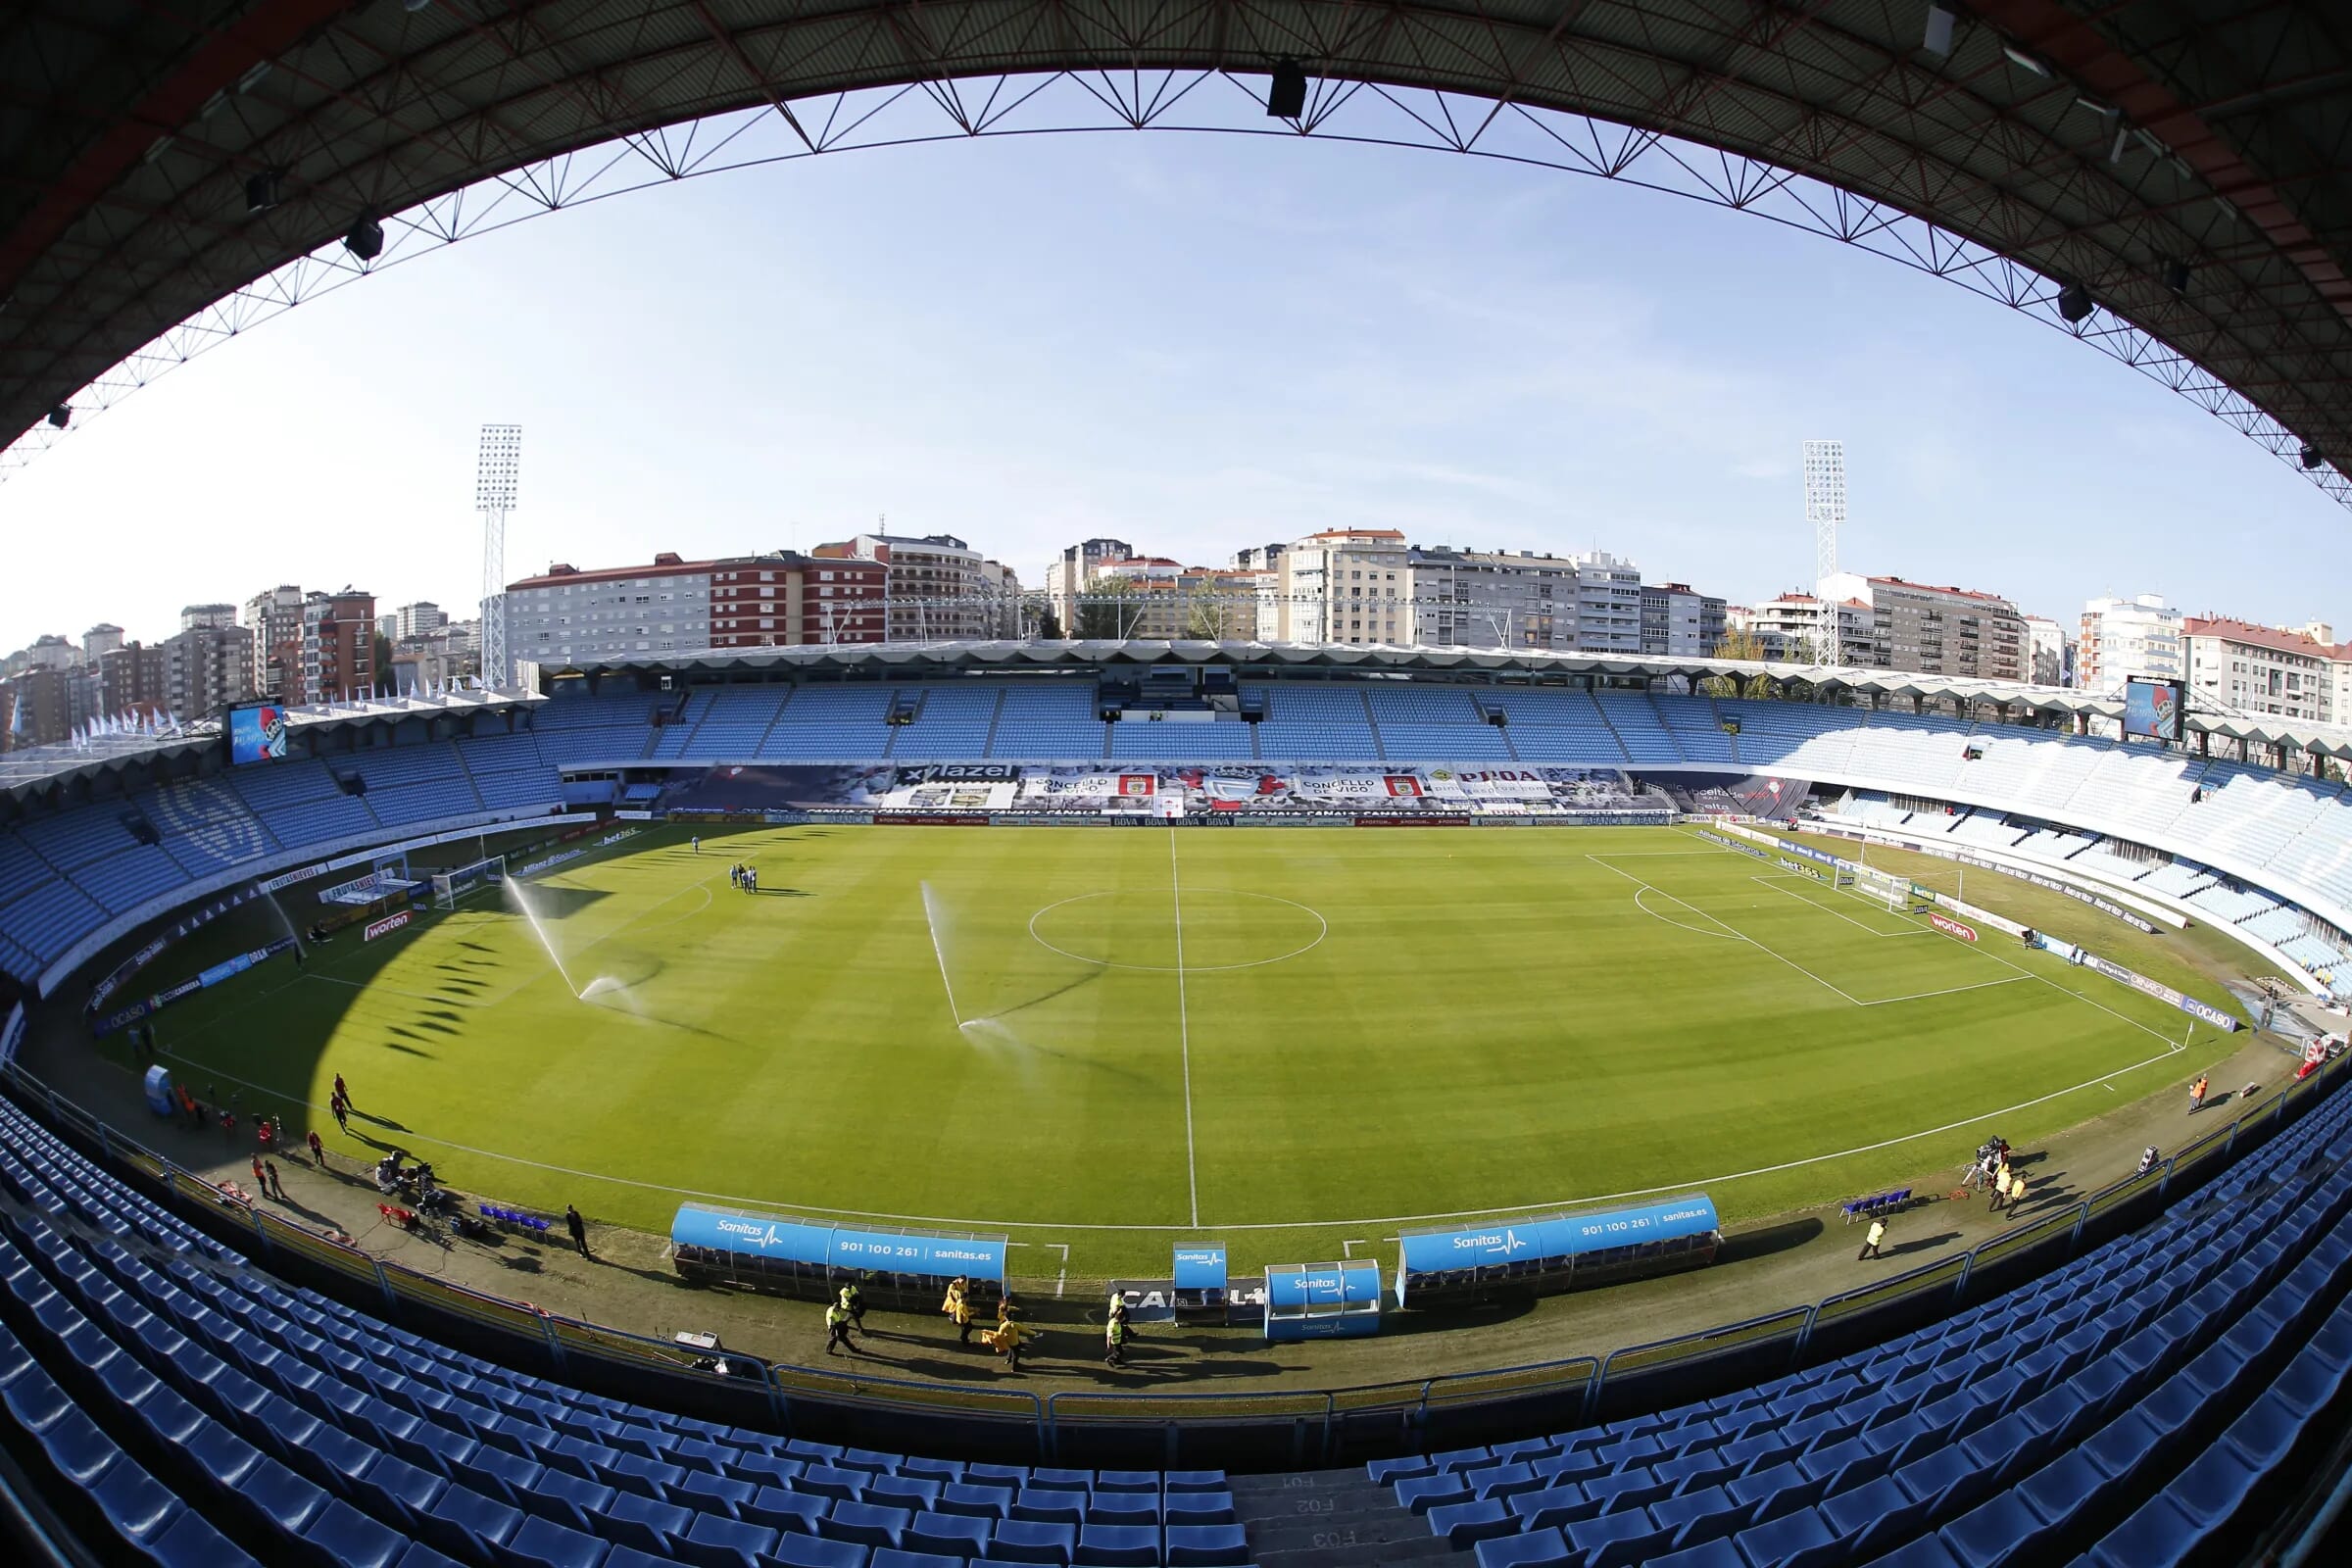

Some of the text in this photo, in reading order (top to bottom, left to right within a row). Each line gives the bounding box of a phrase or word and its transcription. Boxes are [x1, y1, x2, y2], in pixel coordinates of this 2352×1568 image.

[905, 764, 1012, 781] xylazel
[1458, 770, 1540, 782] PROA
[1303, 778, 1375, 790] CONCELLO
[1336, 785, 1369, 794] VIGO
[603, 827, 637, 845] bet365
[1698, 829, 1723, 844] Allianz
[522, 859, 548, 874] Allianz
[1780, 857, 1822, 879] bet365
[369, 913, 408, 938] worten
[1932, 915, 1971, 940] worten
[111, 1004, 146, 1028] OCASO
[2196, 1004, 2230, 1029] OCASO
[716, 1219, 762, 1236] Sanitas
[1582, 1208, 1707, 1236] 901 100 261 sanitas.es
[1453, 1234, 1502, 1250] Sanitas
[841, 1241, 992, 1261] 901 100 261 sanitas.es
[1295, 1278, 1336, 1290] Sanitas
[1297, 1498, 1334, 1513] F02
[1312, 1531, 1356, 1547] F03
